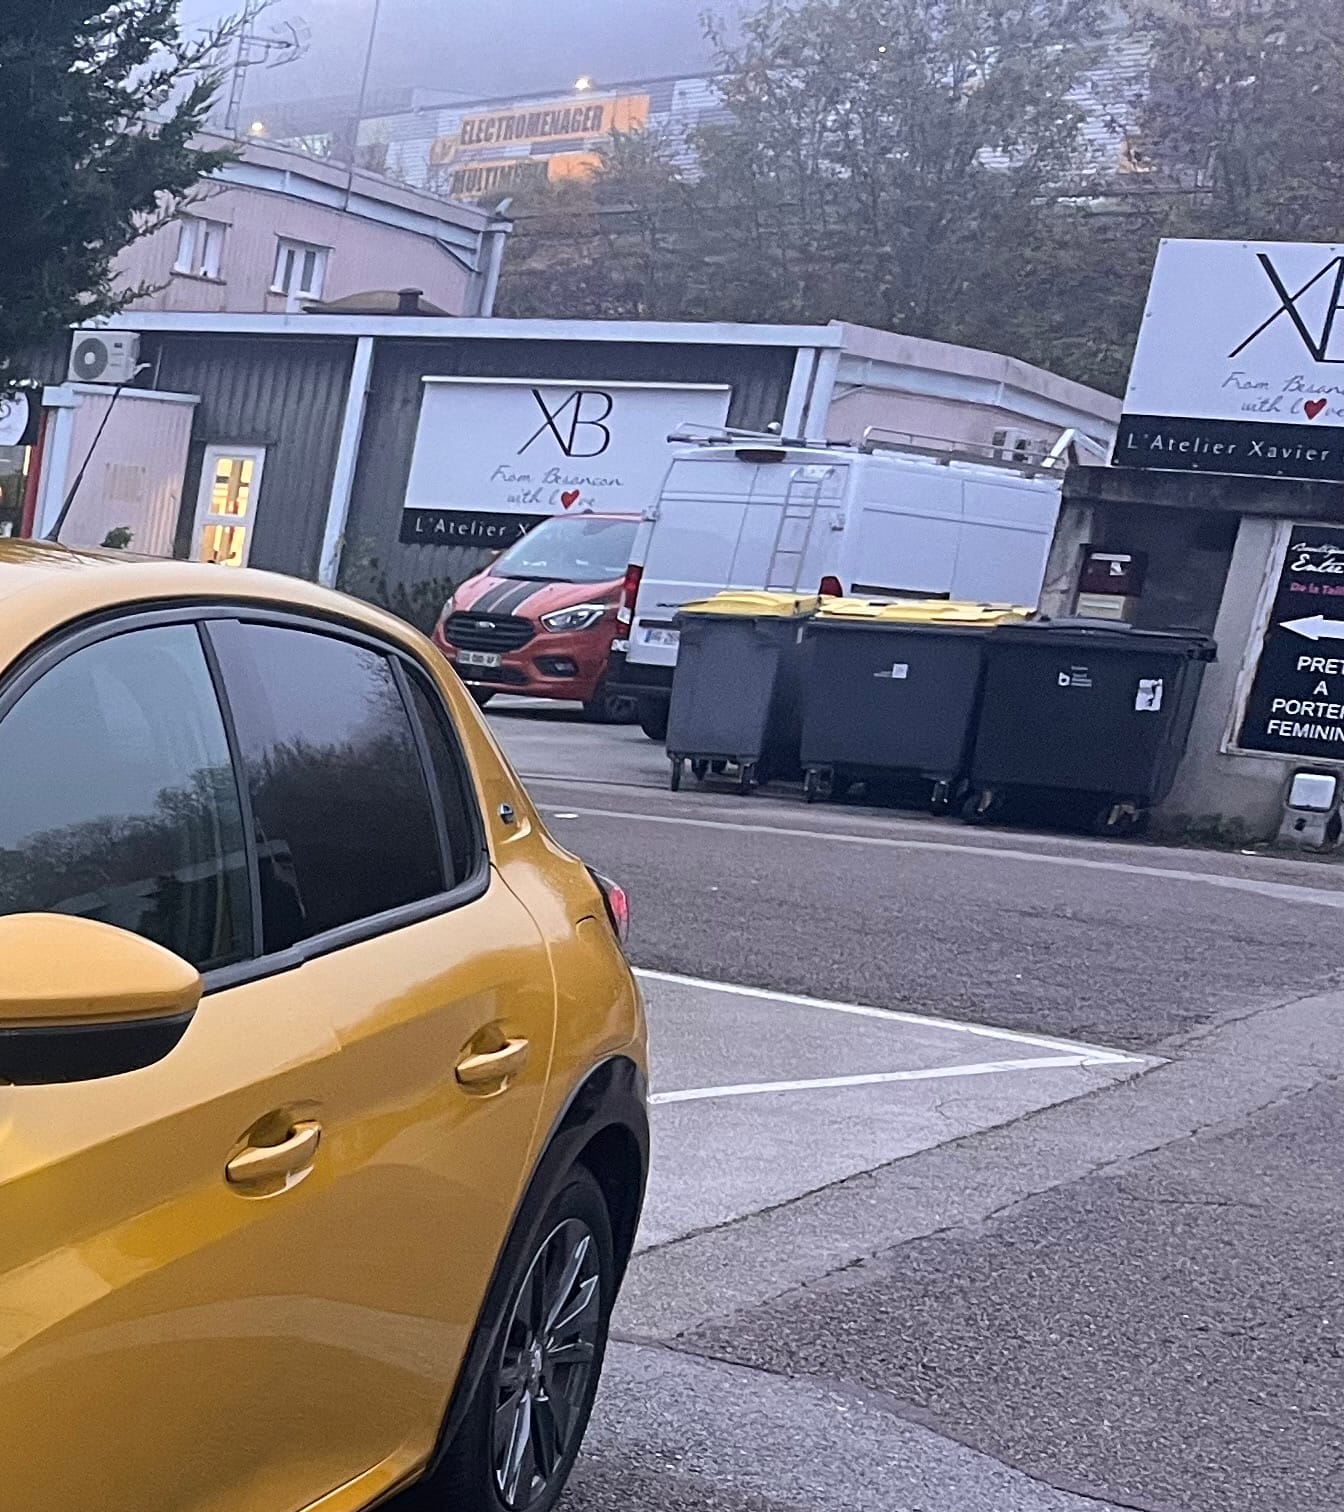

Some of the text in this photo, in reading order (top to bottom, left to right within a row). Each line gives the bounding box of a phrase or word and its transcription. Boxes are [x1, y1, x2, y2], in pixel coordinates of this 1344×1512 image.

[461, 105, 604, 146] ELECTROMENAGER
[1221, 371, 1344, 394] From Besan
[1241, 395, 1284, 413] with
[517, 388, 614, 458] XB
[1127, 433, 1330, 461] L'Atelier Xavier
[490, 464, 531, 483] From
[507, 487, 545, 505] with
[414, 517, 507, 537] L'Atelier
[1313, 680, 1329, 696] A
